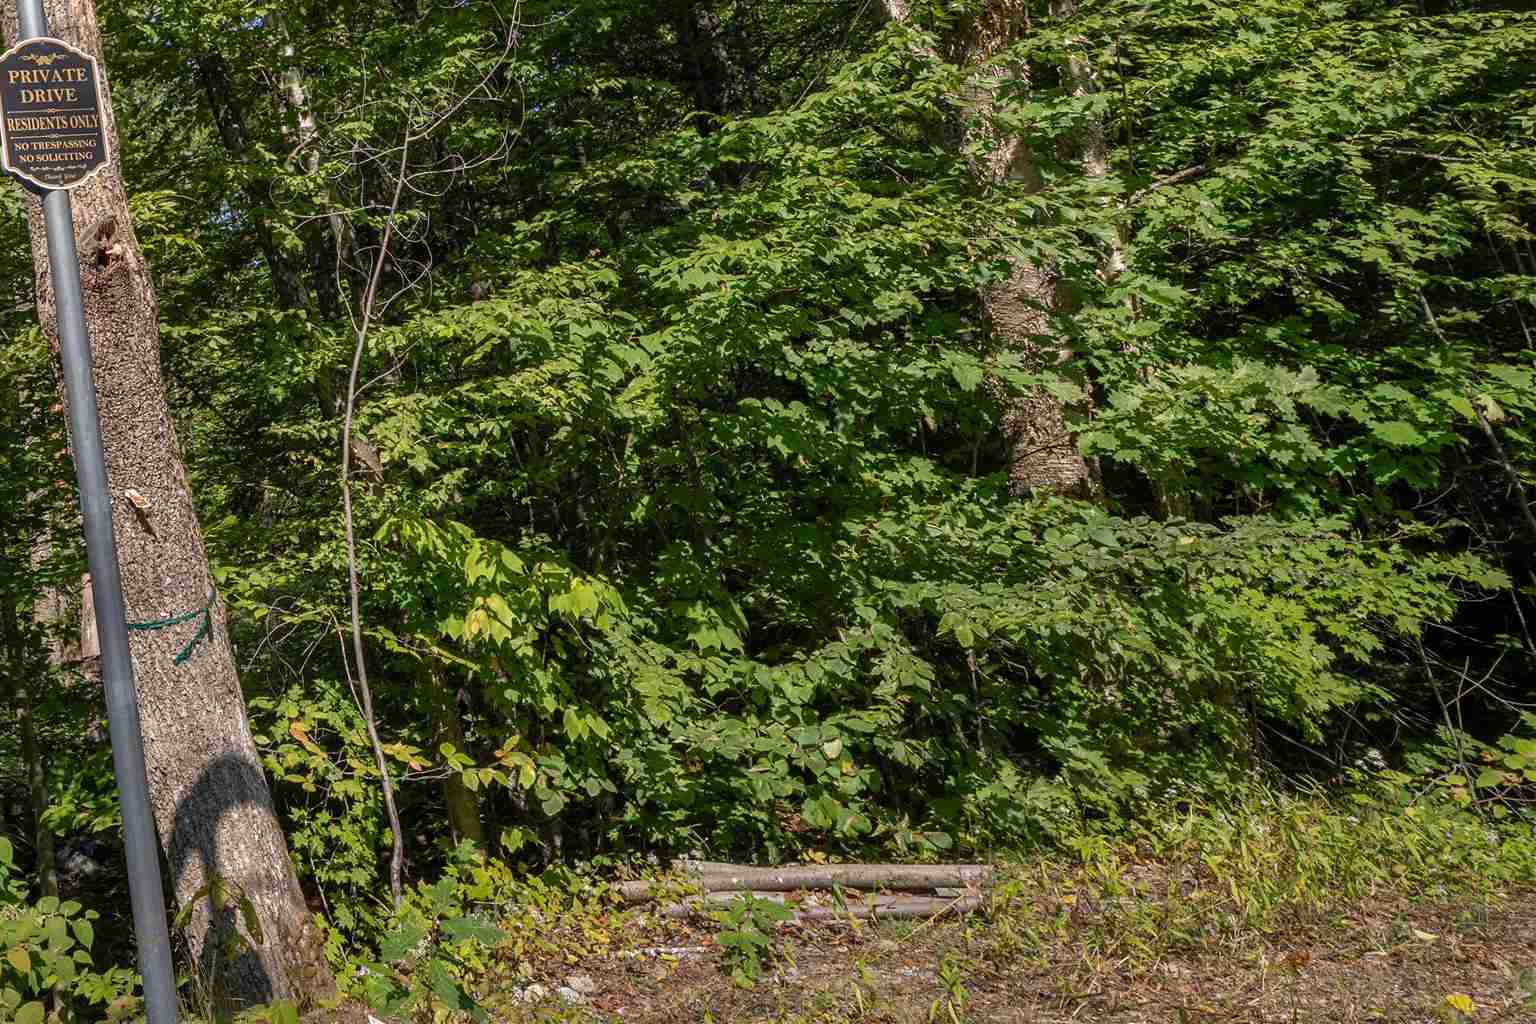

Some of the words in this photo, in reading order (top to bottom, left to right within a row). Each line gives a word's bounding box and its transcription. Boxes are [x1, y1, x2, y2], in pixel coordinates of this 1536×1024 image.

[8, 68, 88, 83] PRIVATE
[20, 88, 79, 103] DRIVE
[7, 116, 68, 131] RESIDENTS
[70, 114, 99, 129] ONLY
[14, 141, 30, 150] NO
[32, 139, 97, 150] TRESPASSING
[19, 154, 35, 163] NO
[36, 152, 94, 161] SOLICITING
